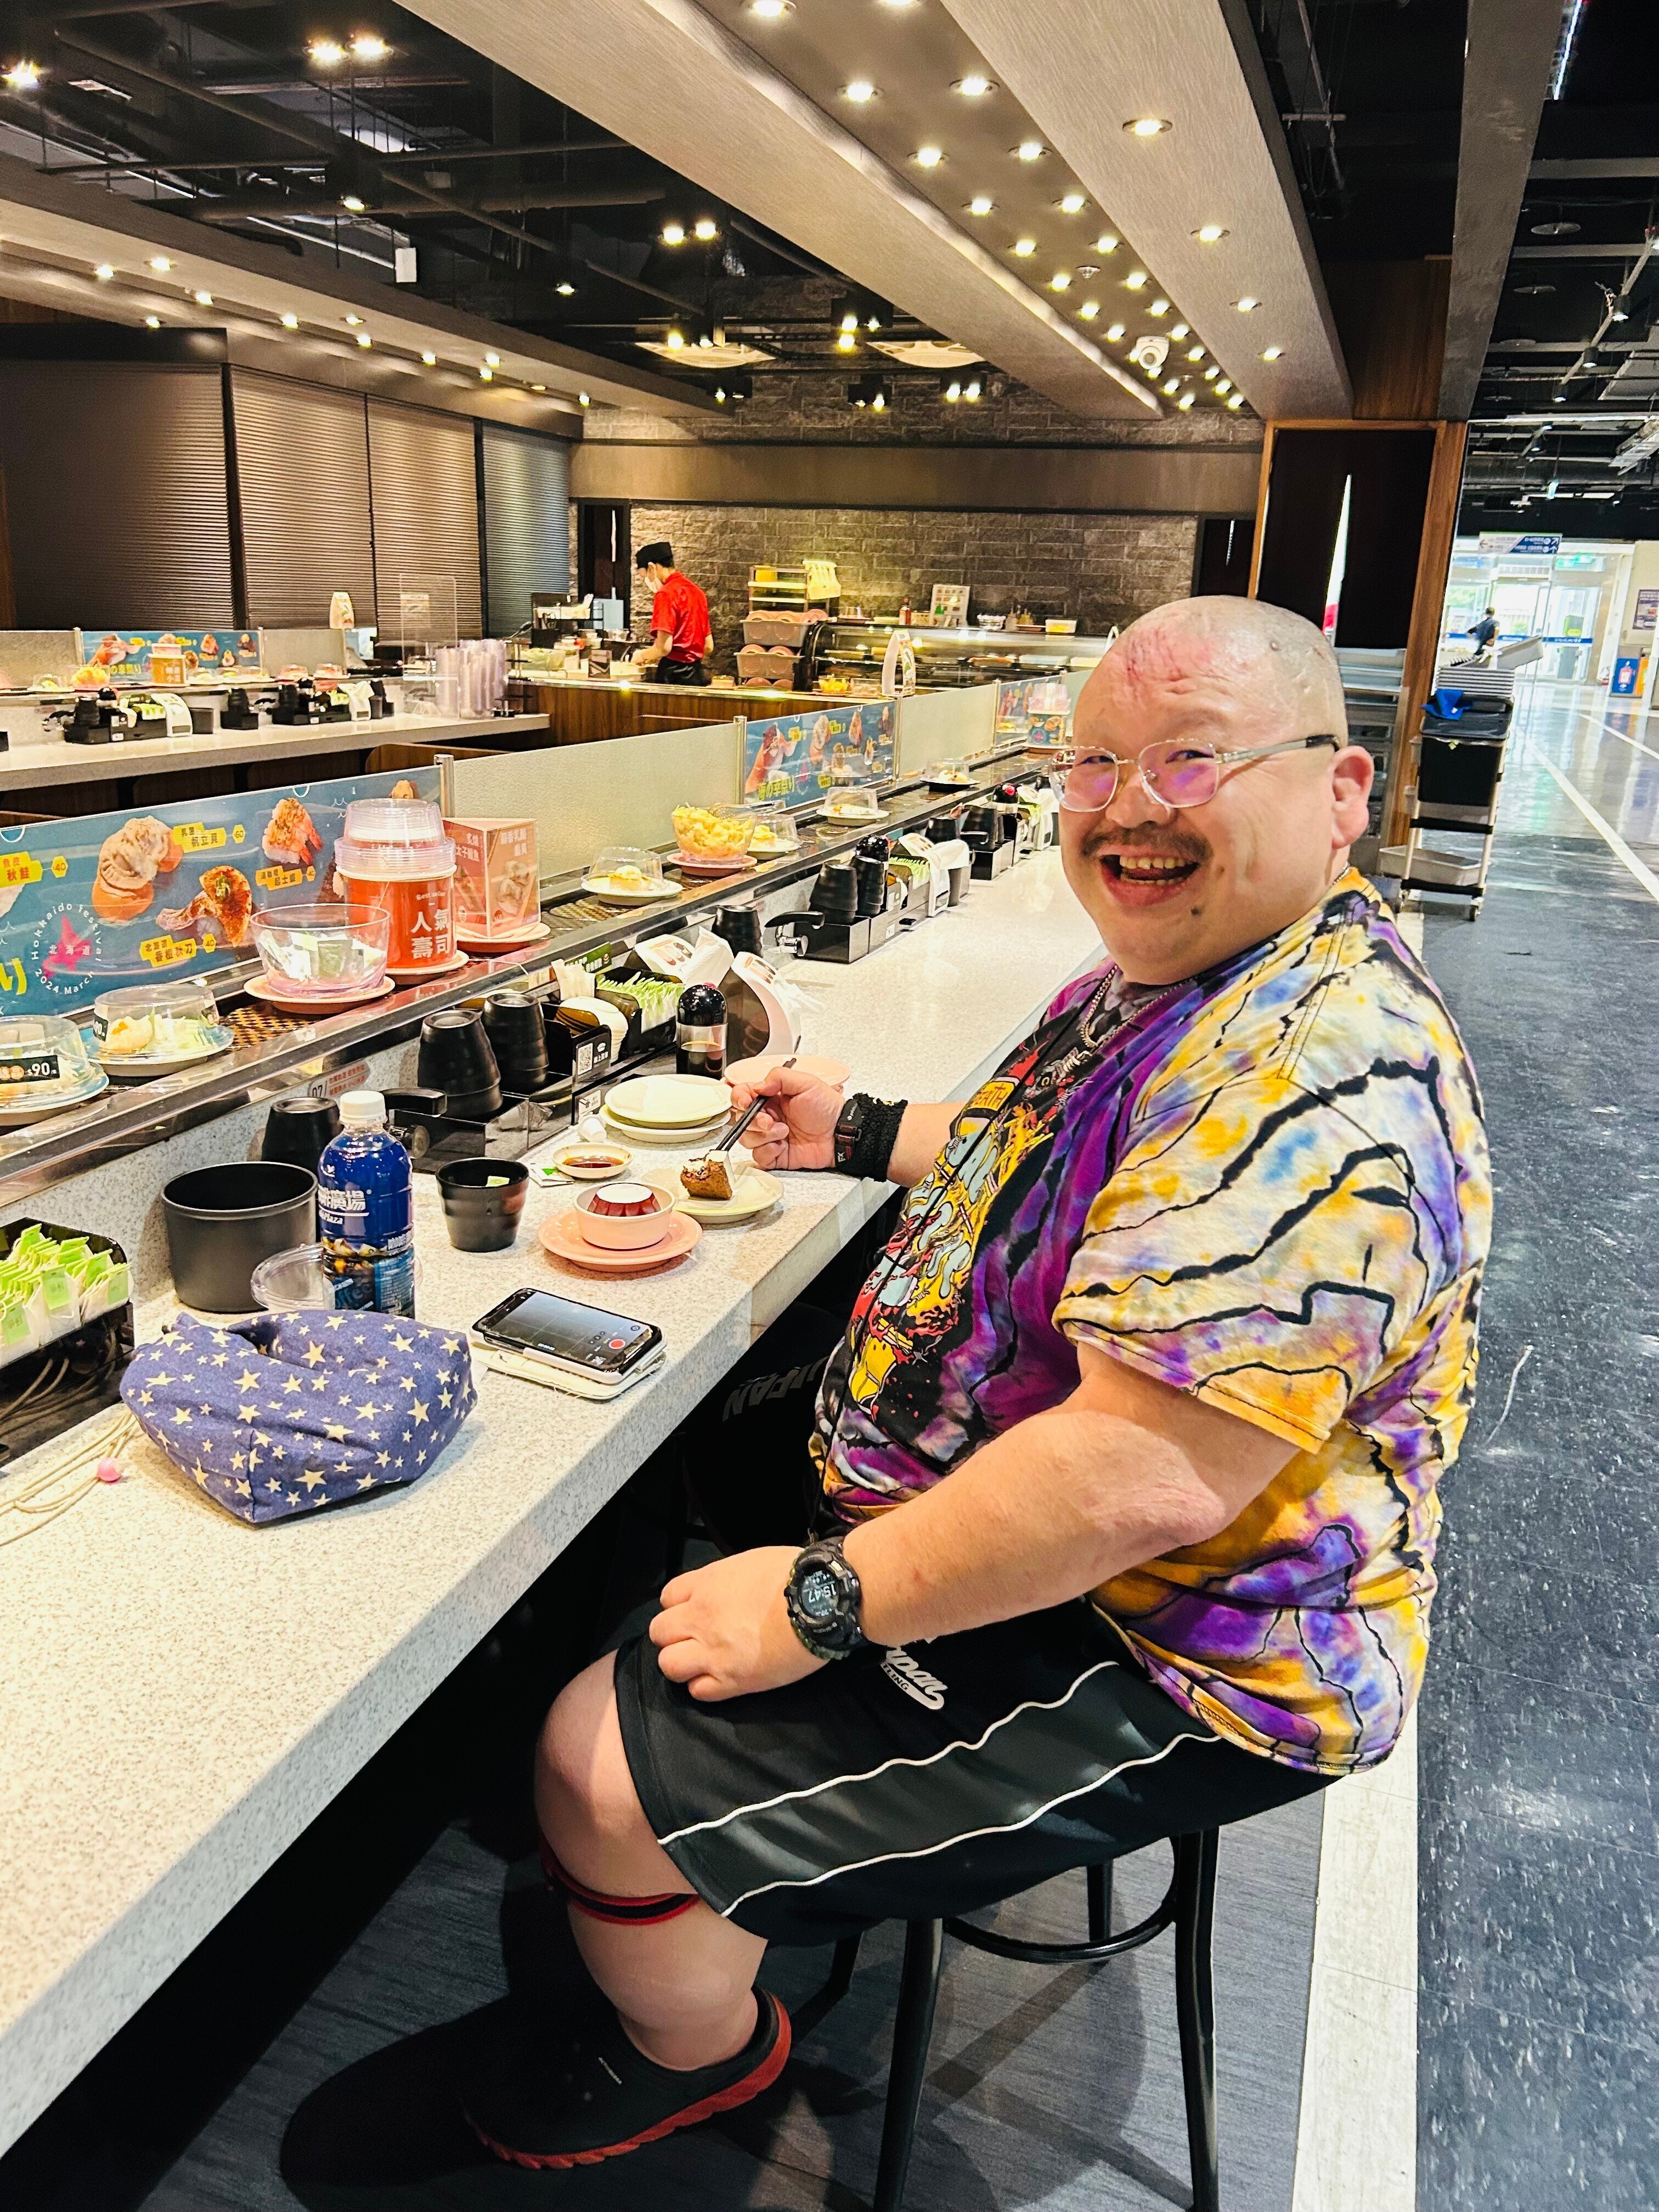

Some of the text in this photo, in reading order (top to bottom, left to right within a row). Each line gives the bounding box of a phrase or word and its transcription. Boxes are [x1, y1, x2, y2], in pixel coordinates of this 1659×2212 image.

[55, 862, 66, 871] 40
[31, 902, 72, 960] Hokkaido
[411, 909, 451, 934] 人氣
[49, 944, 91, 956] 北海道
[411, 933, 450, 960] 壽司
[35, 968, 95, 995] 2024 March
[312, 1084, 323, 1098] 07
